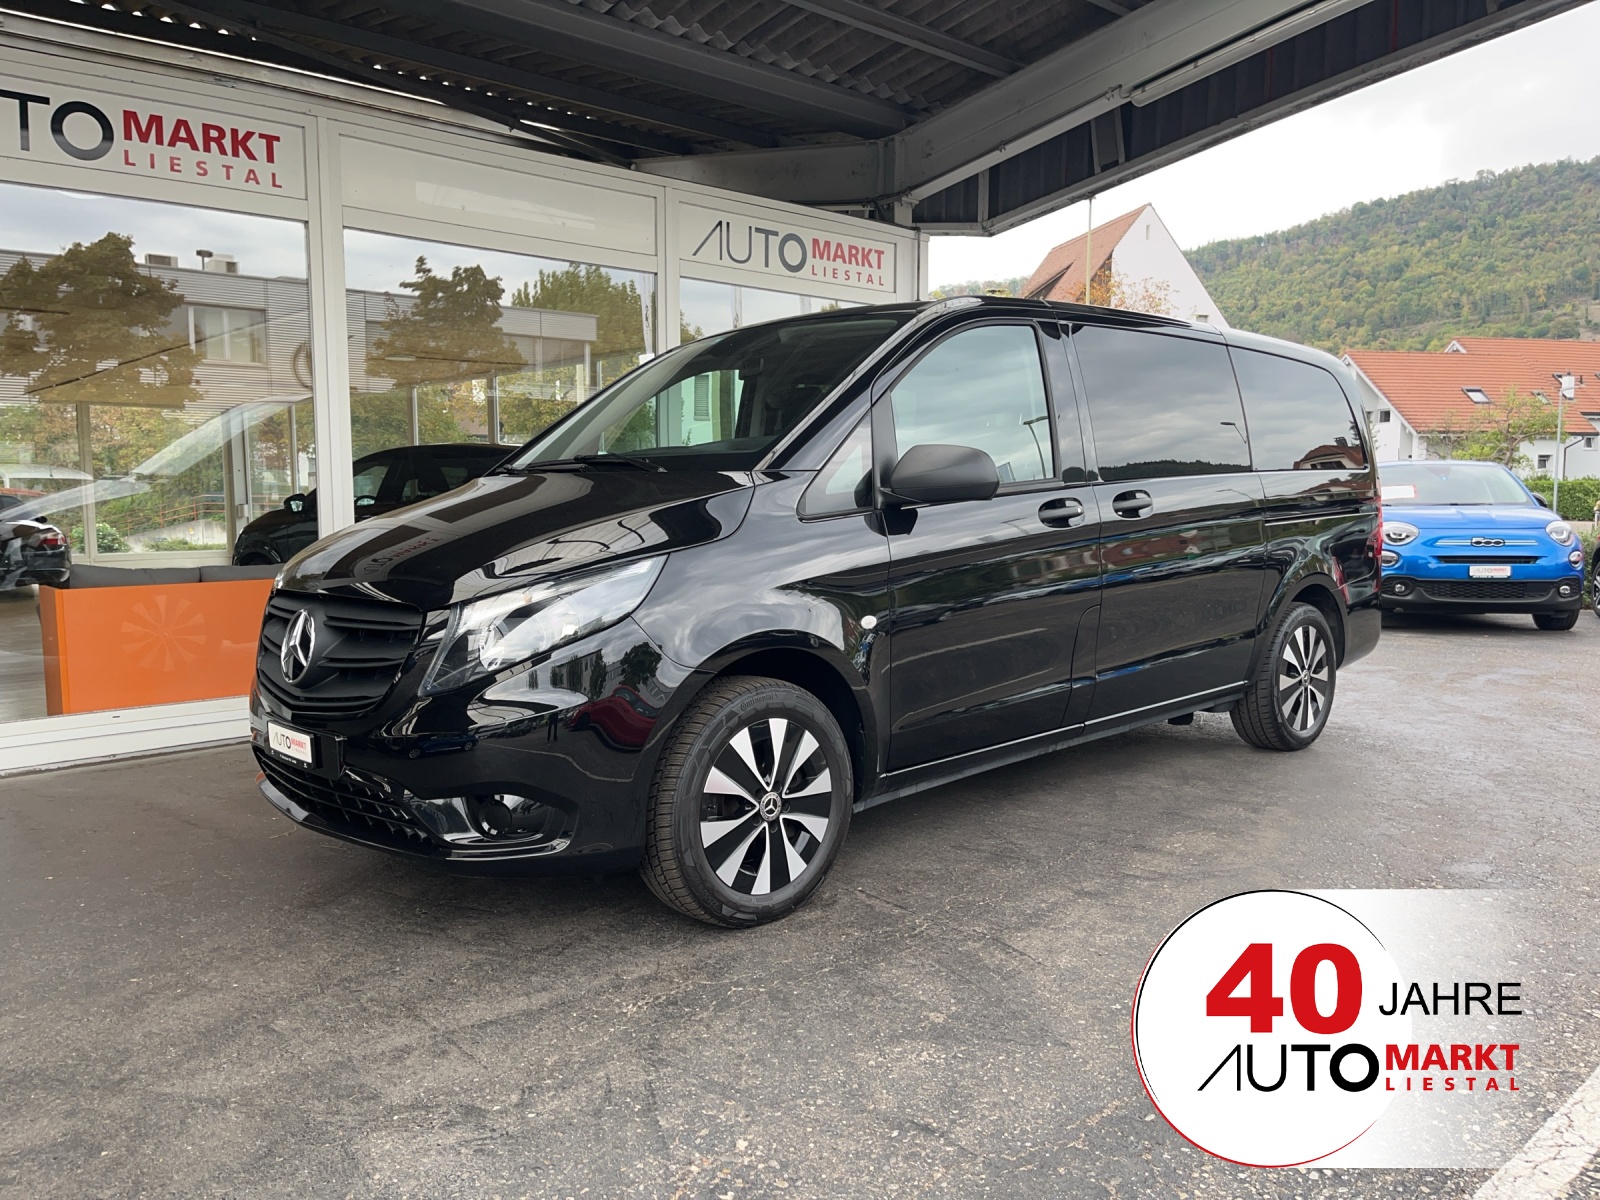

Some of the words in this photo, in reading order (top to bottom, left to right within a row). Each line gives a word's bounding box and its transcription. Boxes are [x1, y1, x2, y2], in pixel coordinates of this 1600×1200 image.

[122, 109, 281, 164] MARKT
[123, 149, 283, 188] LIESTAL
[691, 220, 807, 273] AUTO
[811, 237, 885, 270] MARKT
[811, 264, 885, 286] LIESTAL
[1471, 537, 1505, 547] 500
